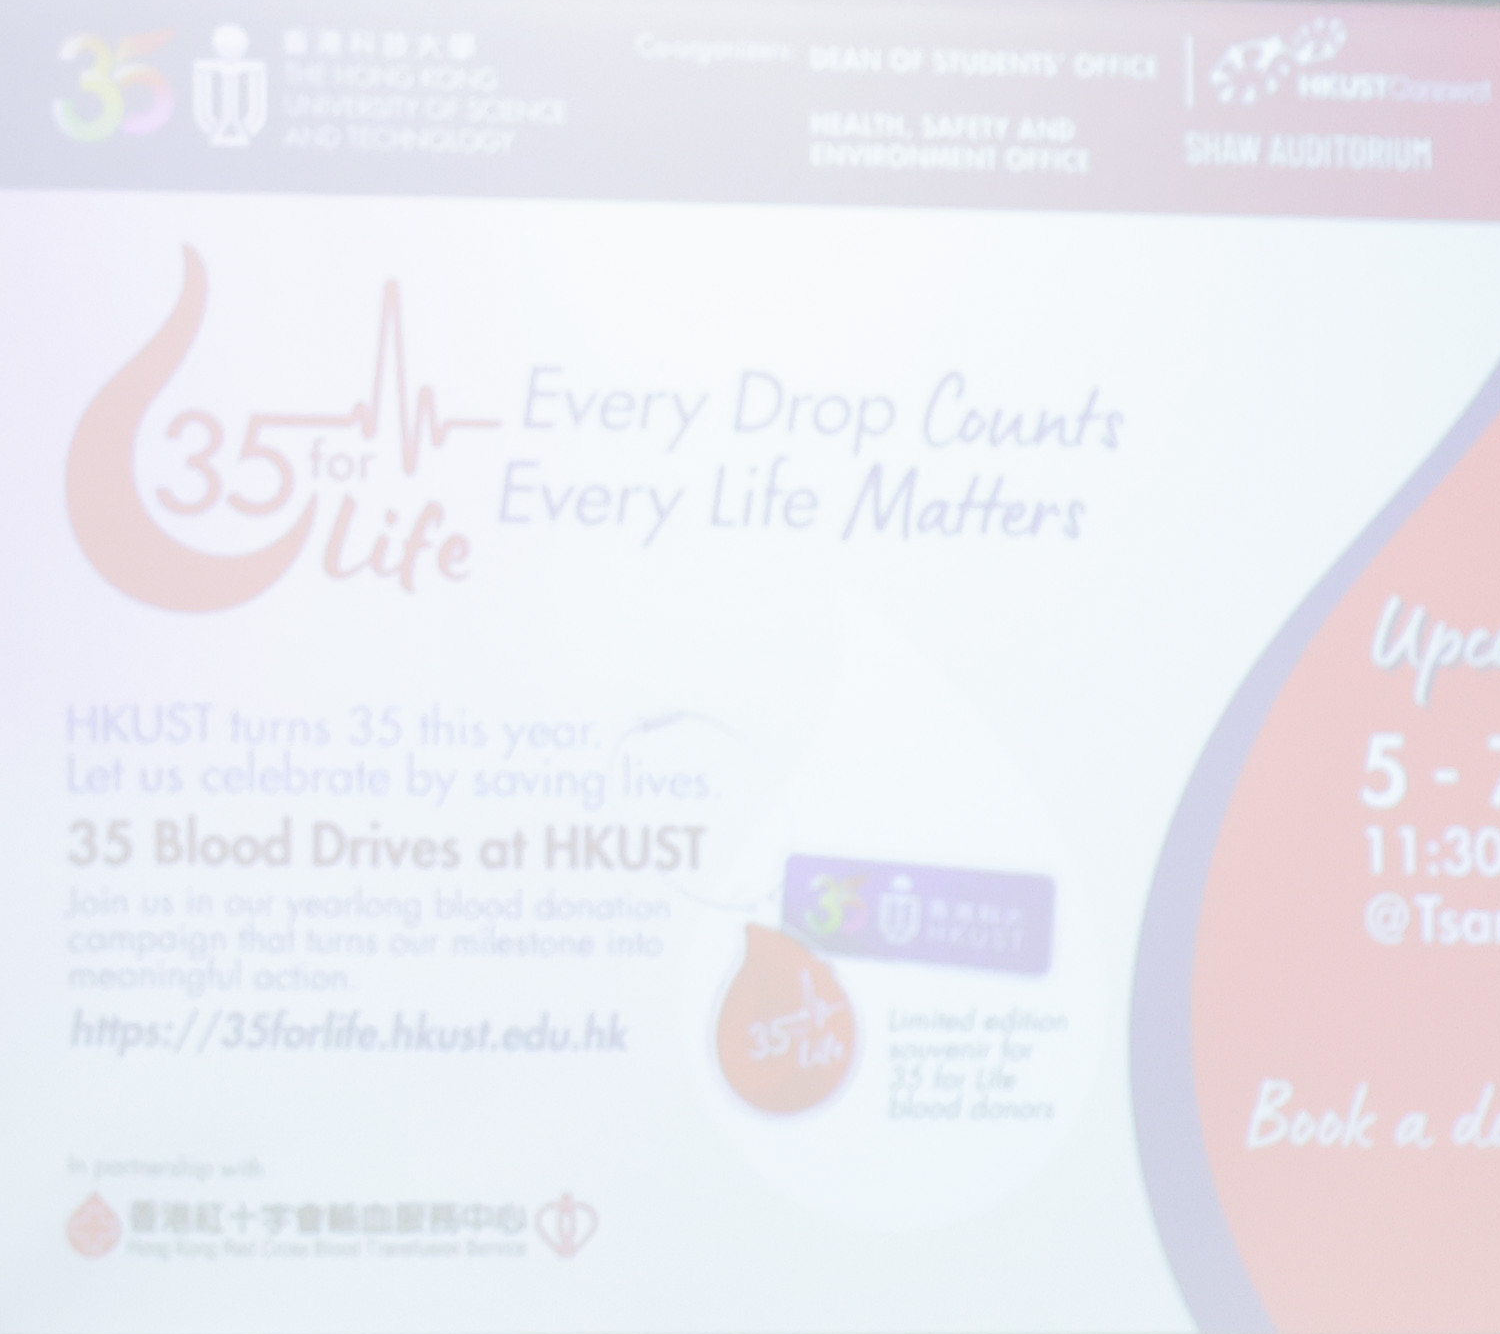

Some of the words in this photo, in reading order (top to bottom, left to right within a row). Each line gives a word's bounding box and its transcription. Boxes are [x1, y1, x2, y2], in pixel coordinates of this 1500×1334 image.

[810, 45, 881, 72] DEAN
[888, 46, 923, 72] OF
[1073, 52, 1159, 80] OFFICE
[921, 114, 1012, 140] SAFETY
[1016, 117, 1077, 142] AND
[1185, 131, 1261, 166] SHAW
[1269, 133, 1433, 170] AUDITORIUM
[1005, 146, 1091, 174] OFFICE
[522, 365, 709, 454] Every
[733, 369, 896, 456] Drop
[923, 370, 1125, 450] Counts
[155, 409, 296, 517] 35
[308, 437, 376, 481] for
[498, 459, 685, 549] Every
[710, 455, 818, 529] Life
[841, 462, 1087, 541] Matters
[322, 493, 472, 595] Life
[65, 701, 213, 746] HKUST
[230, 709, 332, 746] turns
[347, 704, 403, 747] 35
[418, 701, 488, 748] this
[65, 752, 124, 795] Let
[139, 764, 185, 795] us
[200, 749, 392, 797] celebrate
[406, 752, 457, 809] by
[473, 759, 606, 812] saving
[1360, 732, 1408, 810] 5
[66, 817, 134, 868] 35
[153, 813, 294, 868] Blood
[311, 819, 462, 870] Drives
[477, 829, 529, 871] at
[543, 824, 708, 872] HKUST
[433, 886, 525, 921] blood
[66, 923, 228, 961] campaign
[69, 1008, 630, 1057] https://35forlife.hkust.edu.hk
[1246, 1078, 1379, 1150] Book
[1393, 1113, 1435, 1148] a
